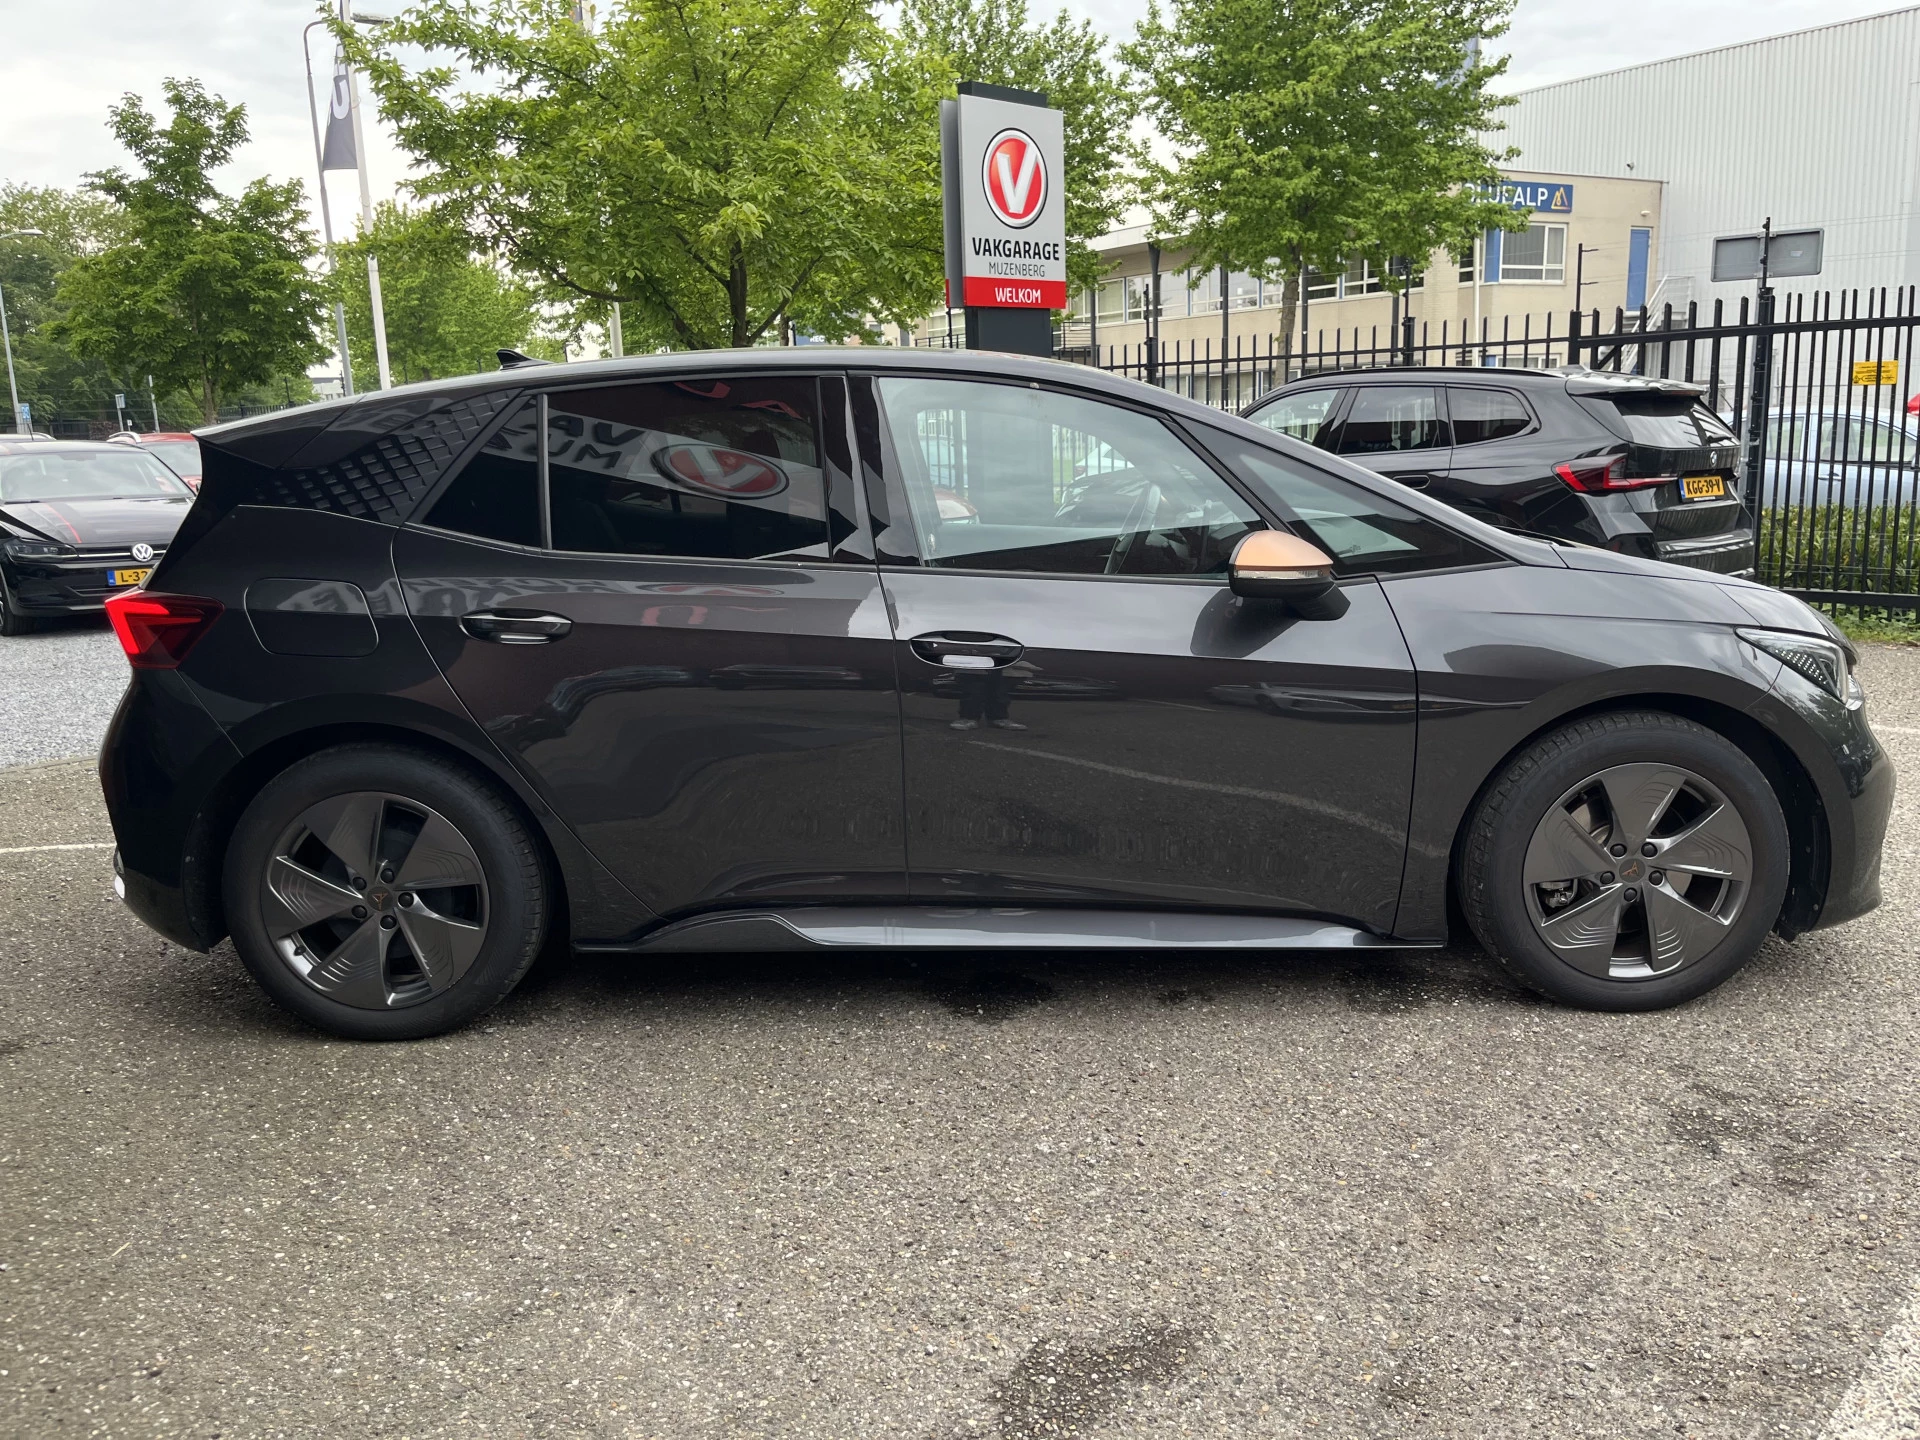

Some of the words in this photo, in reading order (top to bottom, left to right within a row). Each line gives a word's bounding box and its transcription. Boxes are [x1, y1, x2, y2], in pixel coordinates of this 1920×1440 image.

[972, 237, 1060, 261] VAKGARAGE
[988, 261, 1045, 277] MUZENBERG
[994, 287, 1041, 303] WELKOM
[1686, 479, 1721, 495] KGG-39-V
